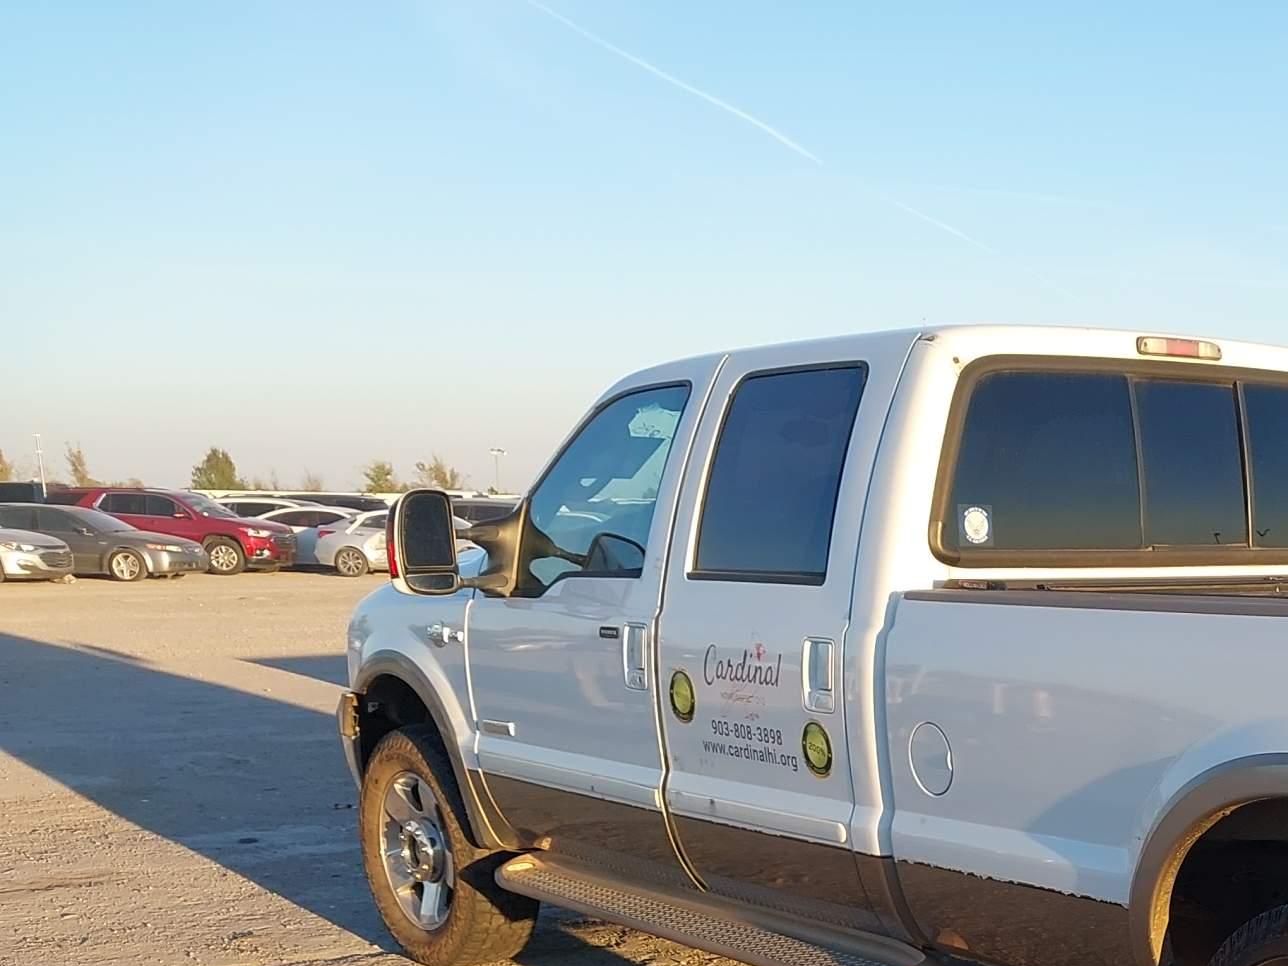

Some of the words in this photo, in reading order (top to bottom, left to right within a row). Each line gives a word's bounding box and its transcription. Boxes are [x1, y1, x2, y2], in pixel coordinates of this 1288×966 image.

[703, 644, 783, 688] Cardinal
[711, 719, 783, 746] 903-808-3898
[703, 740, 799, 772] www.cardinalhi.org
